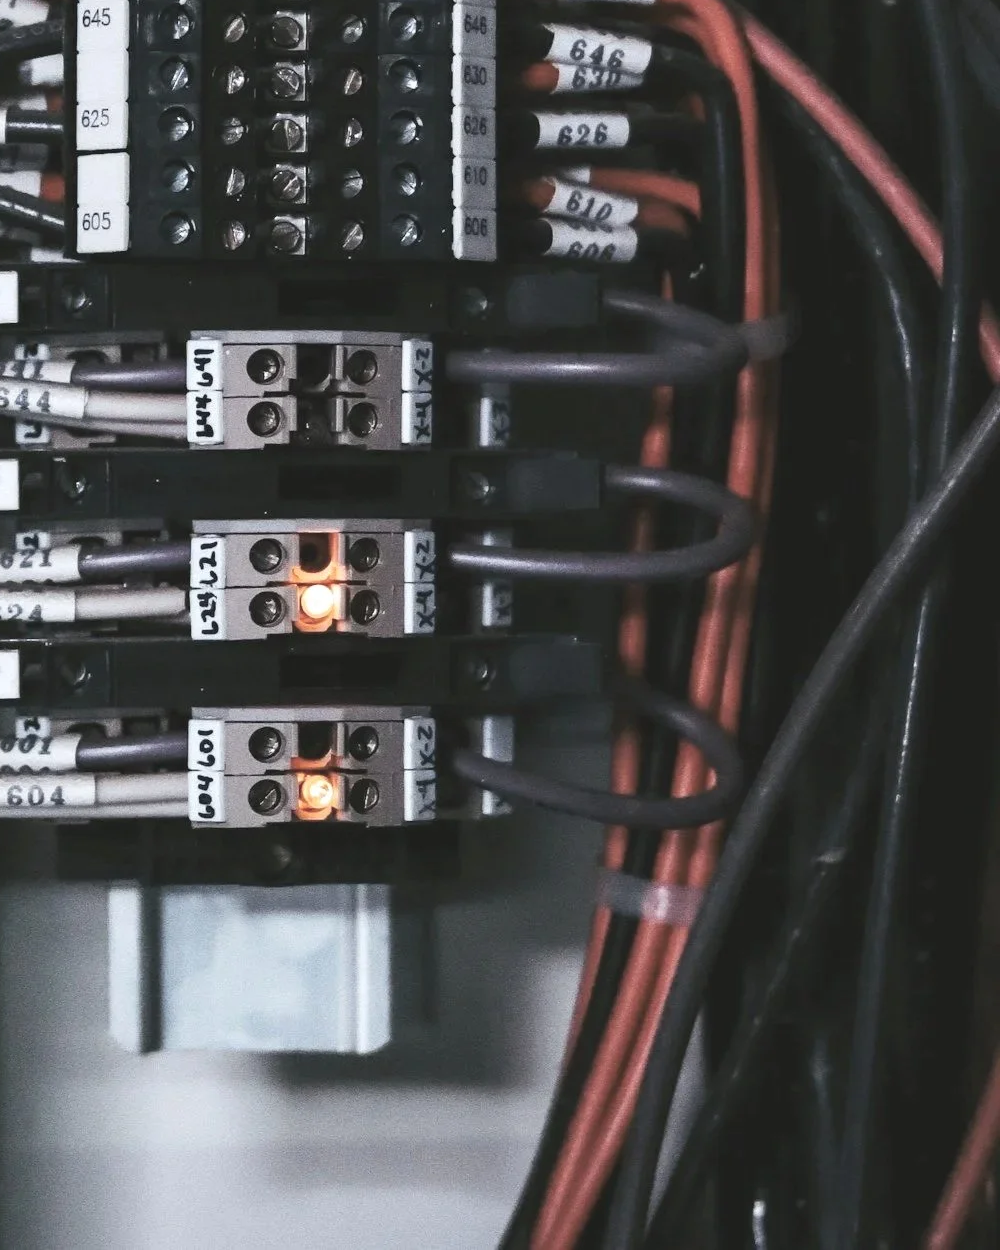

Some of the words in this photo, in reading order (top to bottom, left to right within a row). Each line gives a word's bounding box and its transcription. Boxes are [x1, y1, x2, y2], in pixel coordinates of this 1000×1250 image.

[82, 8, 111, 28] 645
[570, 39, 625, 69] 646
[464, 67, 487, 86] 630
[81, 108, 110, 128] 625
[464, 116, 487, 137] 626
[557, 122, 608, 146] 626
[464, 166, 487, 185] 610
[82, 212, 111, 231] 605
[464, 217, 487, 237] 606
[7, 785, 66, 807] 604
